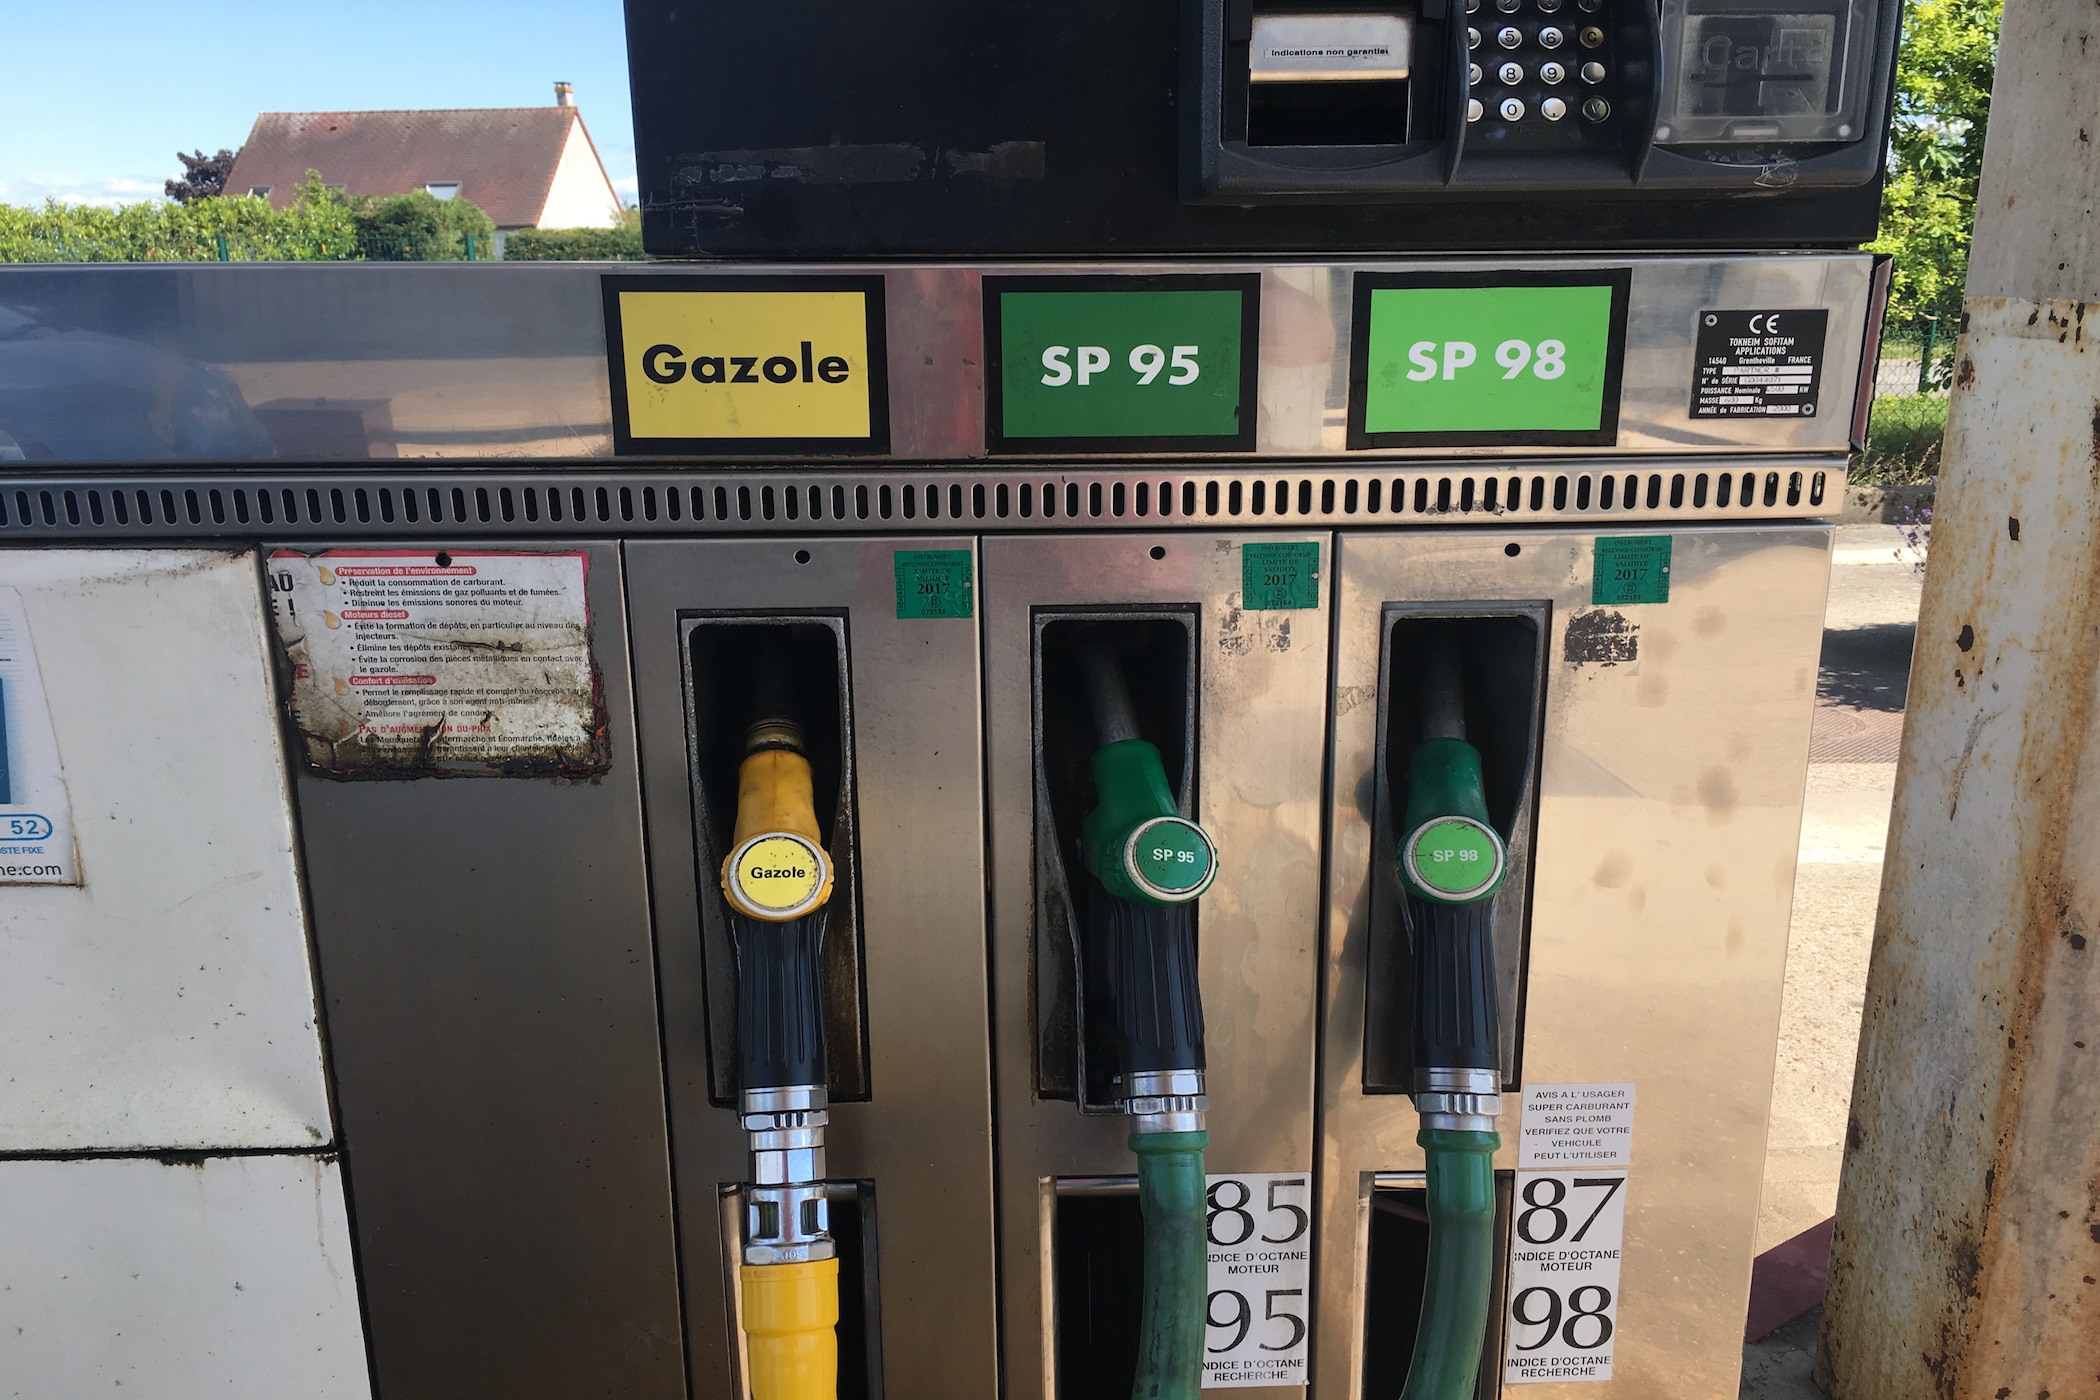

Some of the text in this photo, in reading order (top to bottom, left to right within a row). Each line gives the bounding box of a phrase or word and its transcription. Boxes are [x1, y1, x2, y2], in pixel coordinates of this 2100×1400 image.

[1505, 31, 1515, 41] 5
[1546, 32, 1557, 43] 6
[1587, 31, 1597, 42] C
[1506, 68, 1516, 79] 8
[1547, 67, 1557, 79] 9
[1507, 104, 1517, 115] 0
[1749, 314, 1780, 334] CE
[1730, 338, 1794, 346] TOKHEIM SOFITAM
[1735, 347, 1786, 355] APPLICATIONS
[642, 340, 850, 385] Gazole
[1041, 344, 1200, 387] SP 95
[1406, 339, 1566, 382] SP 98
[1722, 376, 1738, 385] SÉRIE
[1699, 397, 1719, 405] MASSE
[1698, 406, 1718, 414] ANNÉE
[1720, 406, 1727, 414] de
[1730, 406, 1767, 414] FABRICATION
[339, 567, 472, 575] Préservation de l'environnement
[1614, 569, 1648, 580] 2017
[349, 578, 505, 586] Réduit la consommation de carburant.
[1264, 574, 1297, 586] 2017
[350, 589, 561, 597] Restreint les émissions de gaz polluants et de fumées.
[917, 583, 950, 594] 2017
[354, 622, 374, 630] Évite
[376, 622, 383, 630] la
[386, 622, 425, 630] formation
[427, 622, 437, 630] de
[439, 622, 469, 630] dépôts,
[470, 622, 480, 630] en
[482, 622, 522, 630] particulier
[525, 622, 535, 630] au
[537, 622, 564, 630] niveau
[356, 633, 399, 641] injecteurs.
[357, 644, 430, 652] Élimine les dépôts
[359, 655, 378, 663] Évite
[380, 655, 388, 663] la
[390, 655, 427, 663] corrosion
[430, 655, 444, 663] des
[446, 655, 471, 663] pièces
[360, 666, 398, 674] le gazole.
[352, 677, 382, 685] Confort
[362, 689, 390, 697] Permet
[393, 689, 399, 697] le
[401, 689, 448, 697] remplissage
[450, 689, 474, 697] rapide
[477, 689, 484, 697] et
[486, 689, 517, 697] complet
[366, 710, 400, 718] Améliore
[448, 710, 458, 718] de
[11, 820, 40, 835] 52
[22, 846, 44, 855] FIXE
[1153, 849, 1195, 863] SP 95
[1433, 850, 1478, 862] SP 98
[751, 867, 805, 878] Gazole
[1528, 1103, 1630, 1111] SUPER CARBURANT
[1545, 1115, 1612, 1123] SANS PLOMB
[1525, 1127, 1630, 1135] VERIFIEZ QUE VOTRE
[1551, 1139, 1602, 1147] VEHICULE
[1206, 1179, 1309, 1246] 85
[1517, 1177, 1625, 1244] 87
[1246, 1252, 1308, 1262] D'OCTANE
[1515, 1250, 1620, 1261] INDICE D'OCTANE
[1228, 1264, 1279, 1274] MOTEUR
[1540, 1262, 1592, 1271] MOTEUR
[1206, 1289, 1306, 1353] 95
[1513, 1285, 1613, 1350] 98
[1244, 1359, 1305, 1369] D'OCTANE
[1507, 1356, 1611, 1367] INDICE D'OCTANE
[1214, 1370, 1288, 1381] RECHERCHE
[1521, 1367, 1596, 1377] RECHERCHE
